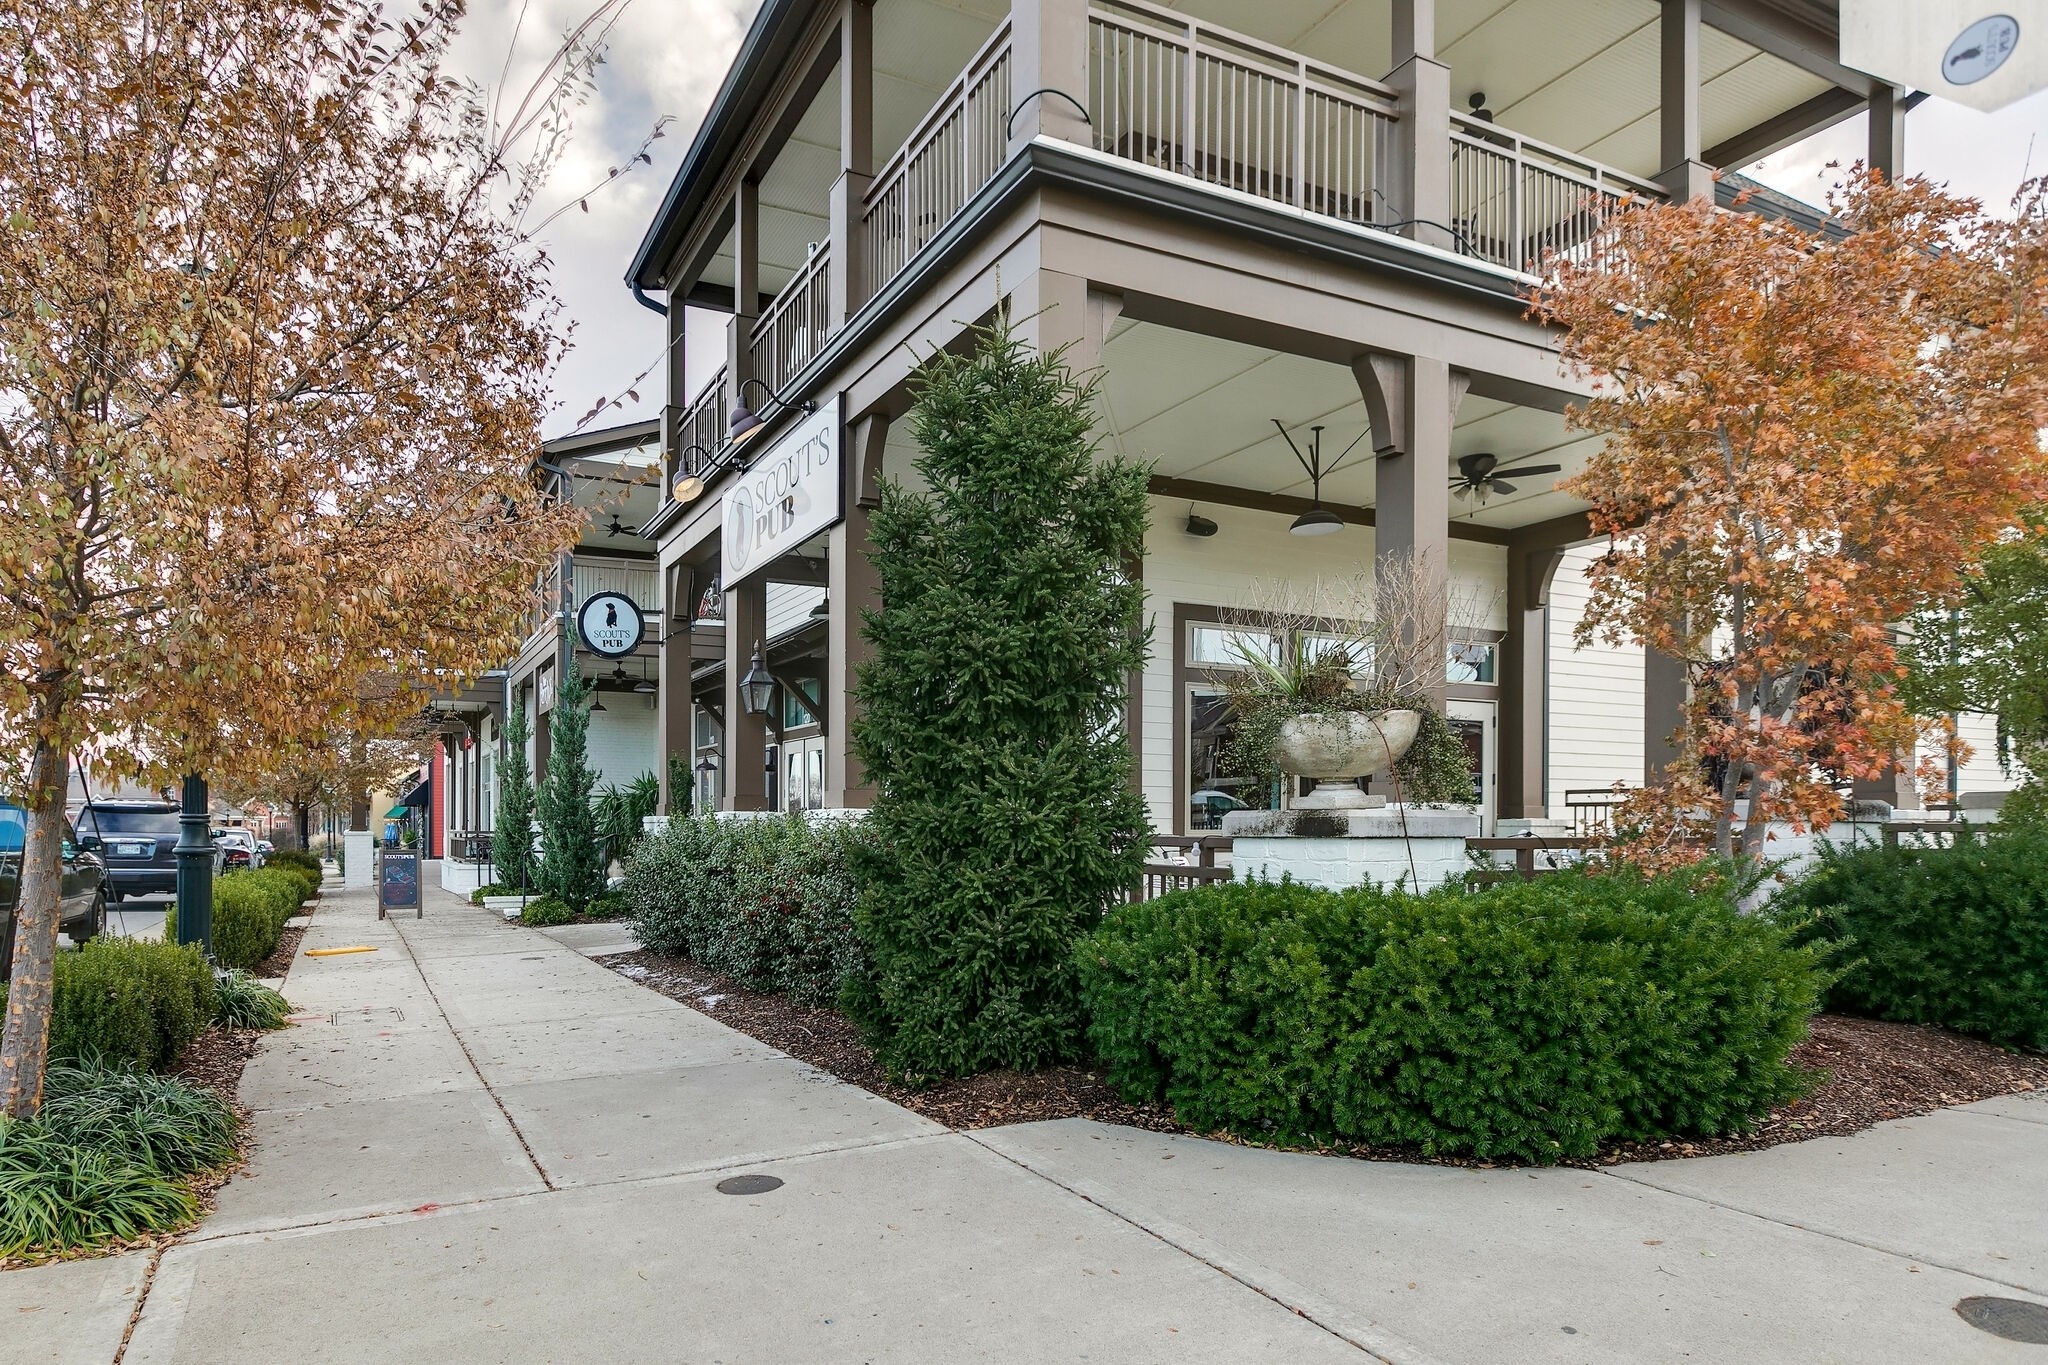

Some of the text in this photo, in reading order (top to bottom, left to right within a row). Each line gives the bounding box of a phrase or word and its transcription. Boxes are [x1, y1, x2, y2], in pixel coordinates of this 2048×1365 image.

[755, 426, 830, 514] SCOUT'S
[755, 495, 795, 550] PUB
[602, 639, 623, 648] PUB
